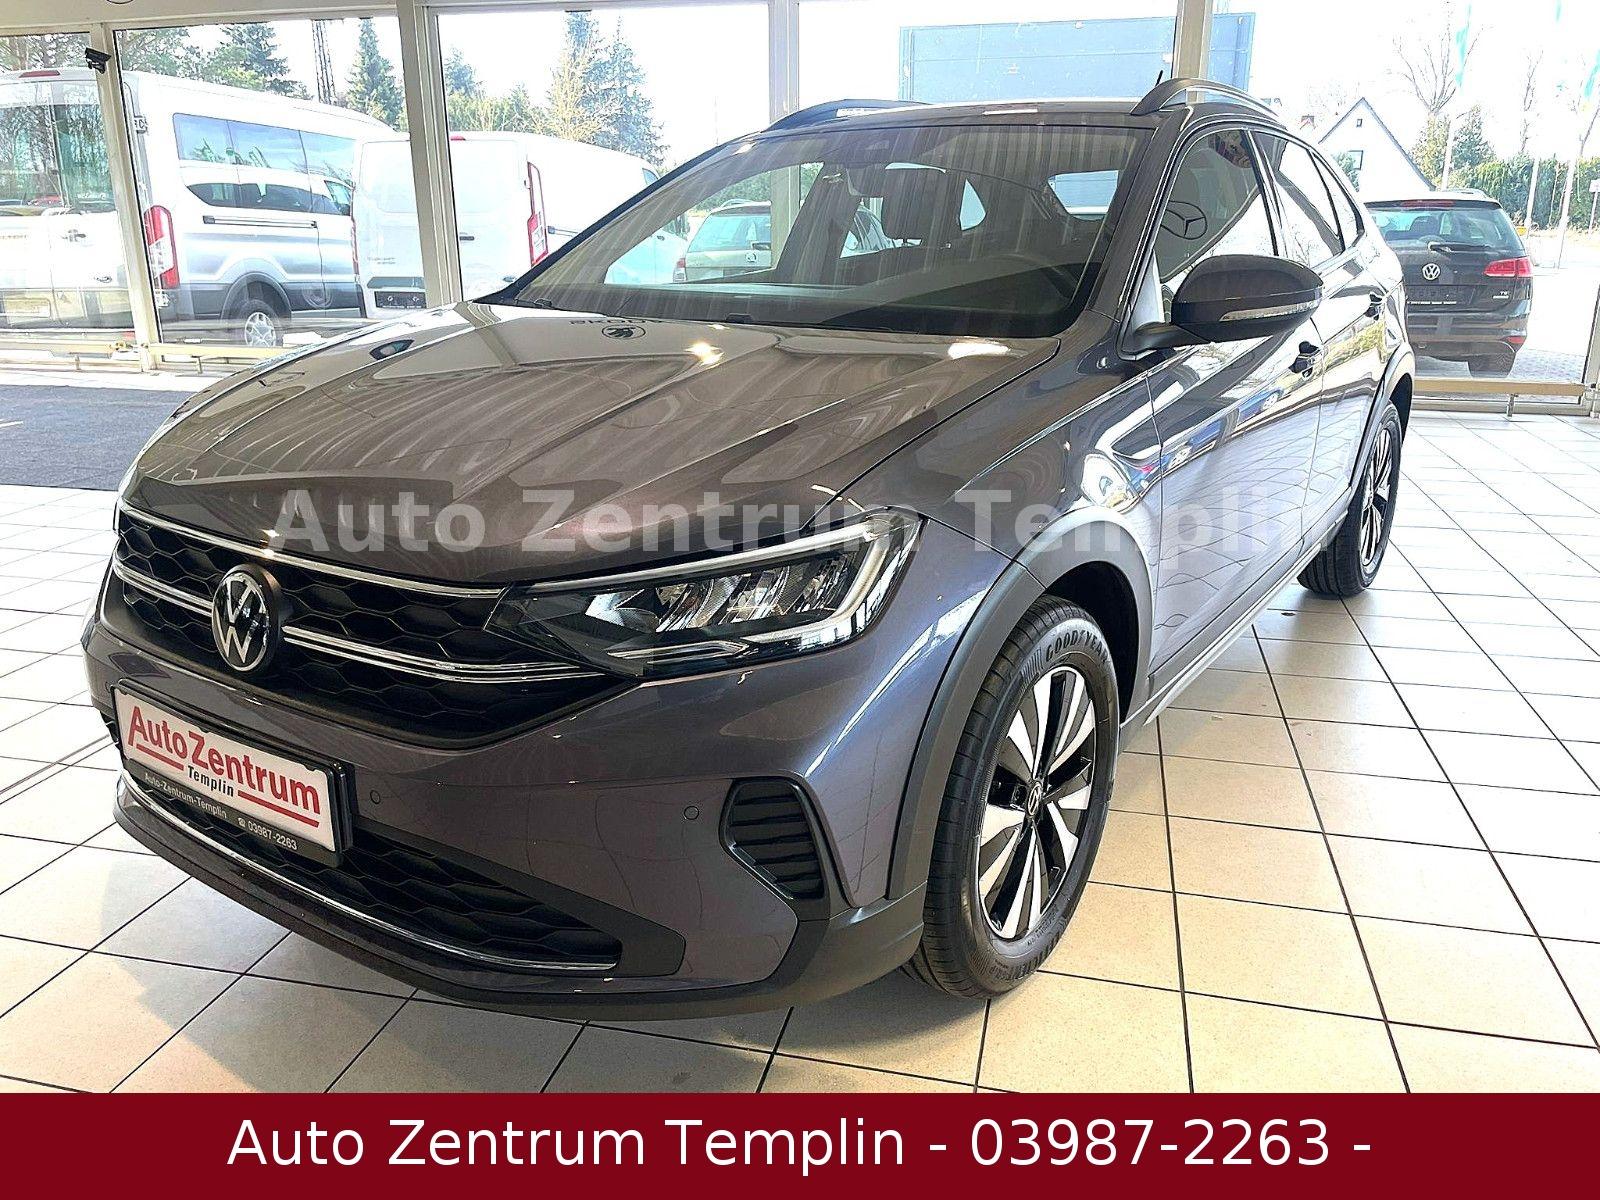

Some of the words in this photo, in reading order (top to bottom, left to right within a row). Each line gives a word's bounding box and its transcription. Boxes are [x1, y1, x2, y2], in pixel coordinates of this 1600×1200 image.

[1046, 630, 1108, 664] GOODYEAR
[187, 765, 234, 797] Templin
[248, 821, 297, 850] 03987-2263
